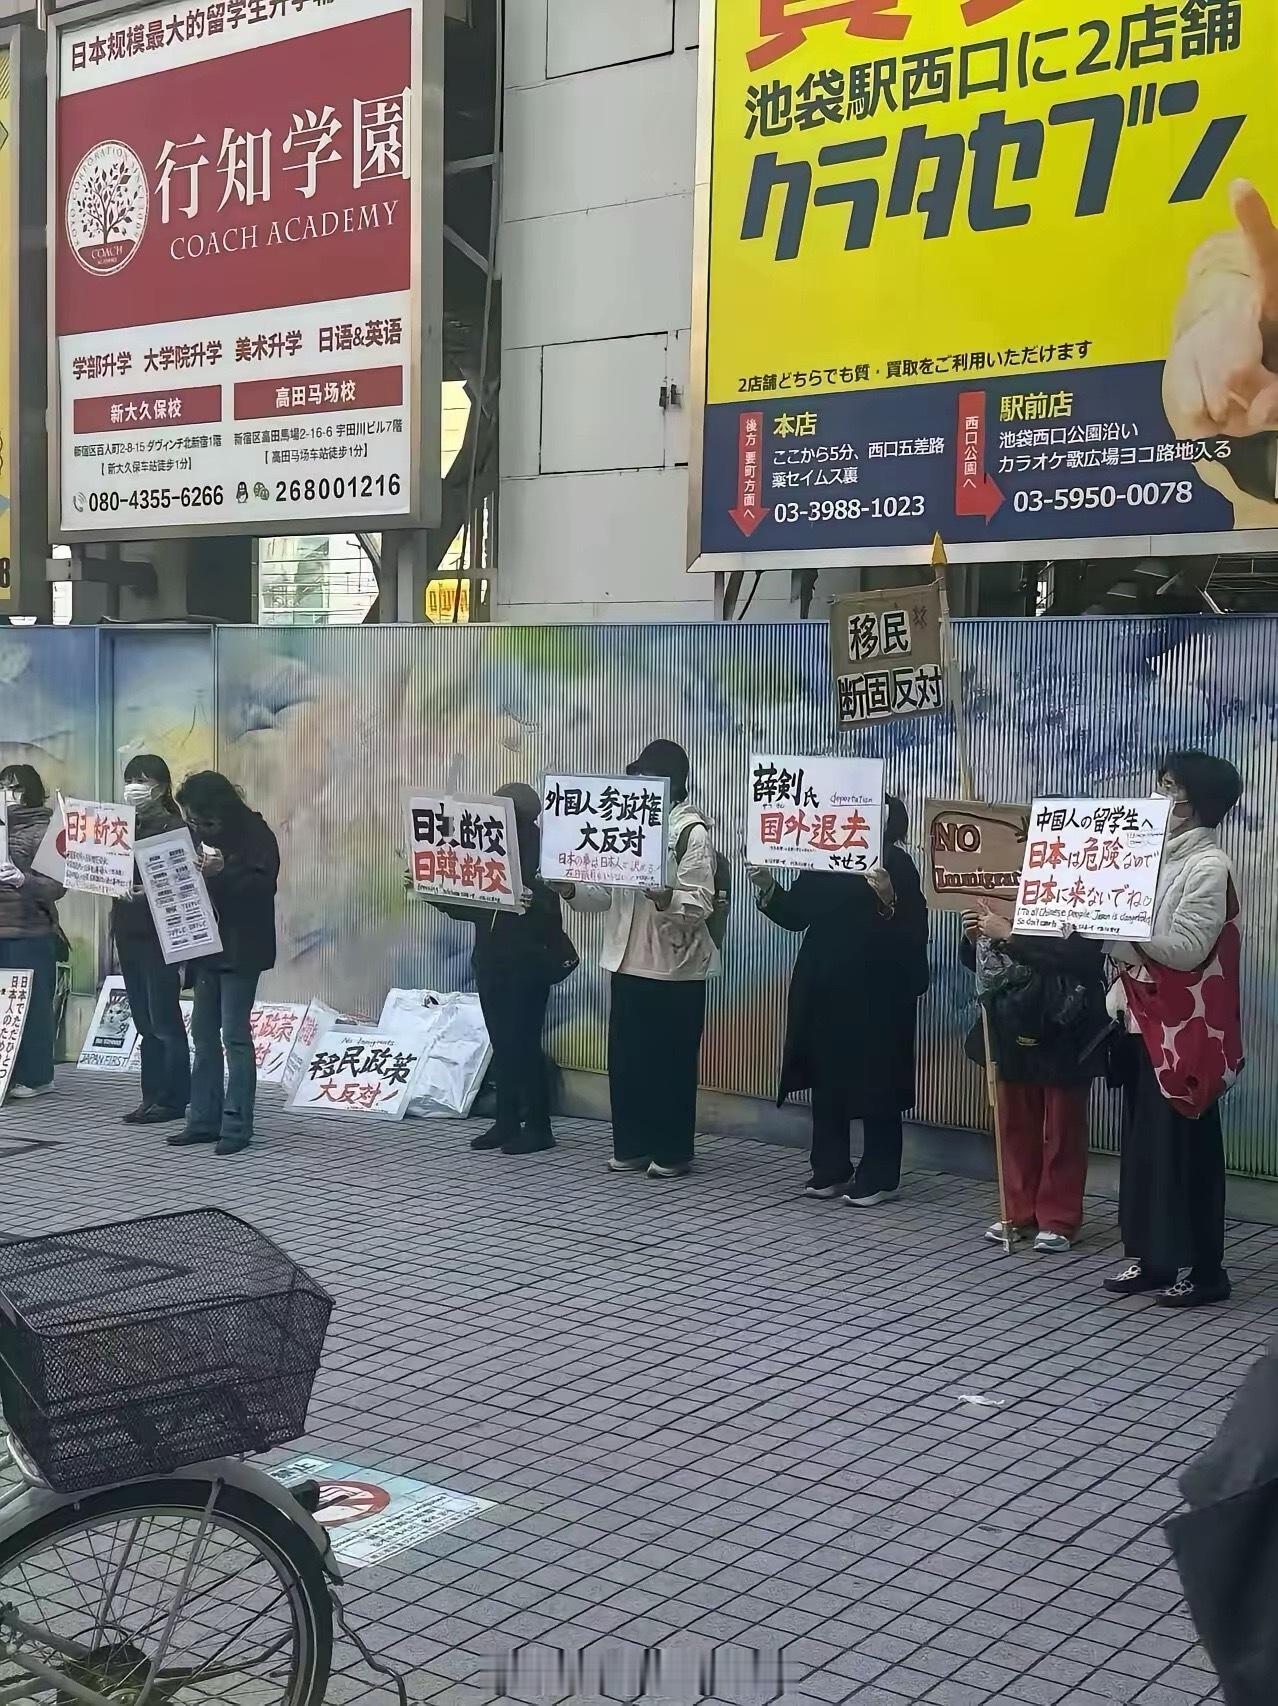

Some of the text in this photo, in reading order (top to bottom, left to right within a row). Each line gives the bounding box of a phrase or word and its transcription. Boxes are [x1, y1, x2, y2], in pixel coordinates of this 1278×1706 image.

[744, 0, 1242, 140] 池袋駅西口に2店舗
[154, 87, 411, 224] 行知学園
[740, 79, 1248, 261] クラタセブン
[170, 200, 399, 261] COACH ACADEMY
[72, 318, 402, 380] 学部升学 大学院升学 美术升学 日语&英语
[738, 340, 1092, 393] 2店舗どちらでも質・買取をご利用いただけます
[110, 397, 182, 424] 新大久保校
[275, 379, 356, 408] 高田马场校
[1000, 390, 1074, 422] 駅前店
[773, 411, 818, 438] 本店
[999, 422, 1139, 449] 池袋西口公園沿い
[773, 436, 945, 465] ここから5分、西口五差路
[963, 415, 979, 489] 西口公園へ
[998, 440, 1232, 474] カラオケ歌広場ヨコ路地入る
[275, 473, 401, 502] 268001216
[771, 466, 859, 488] 薬セイムス裏
[88, 484, 224, 512] 080-4355-6266
[774, 495, 925, 524] 03-3988-1023
[1013, 480, 1193, 513] 03-5950-0078
[849, 611, 909, 660] 移民
[837, 666, 942, 720] 断固反対
[545, 783, 662, 827] 外国人参政権
[1036, 805, 1153, 834] 中国人の留学生へ
[575, 822, 646, 857] 大反対
[760, 808, 871, 851] 国外退去
[935, 822, 981, 852] NO
[414, 846, 512, 894] 日韓断交
[1029, 836, 1159, 871] 日本は危険なので
[308, 1046, 417, 1085] 移民政策
